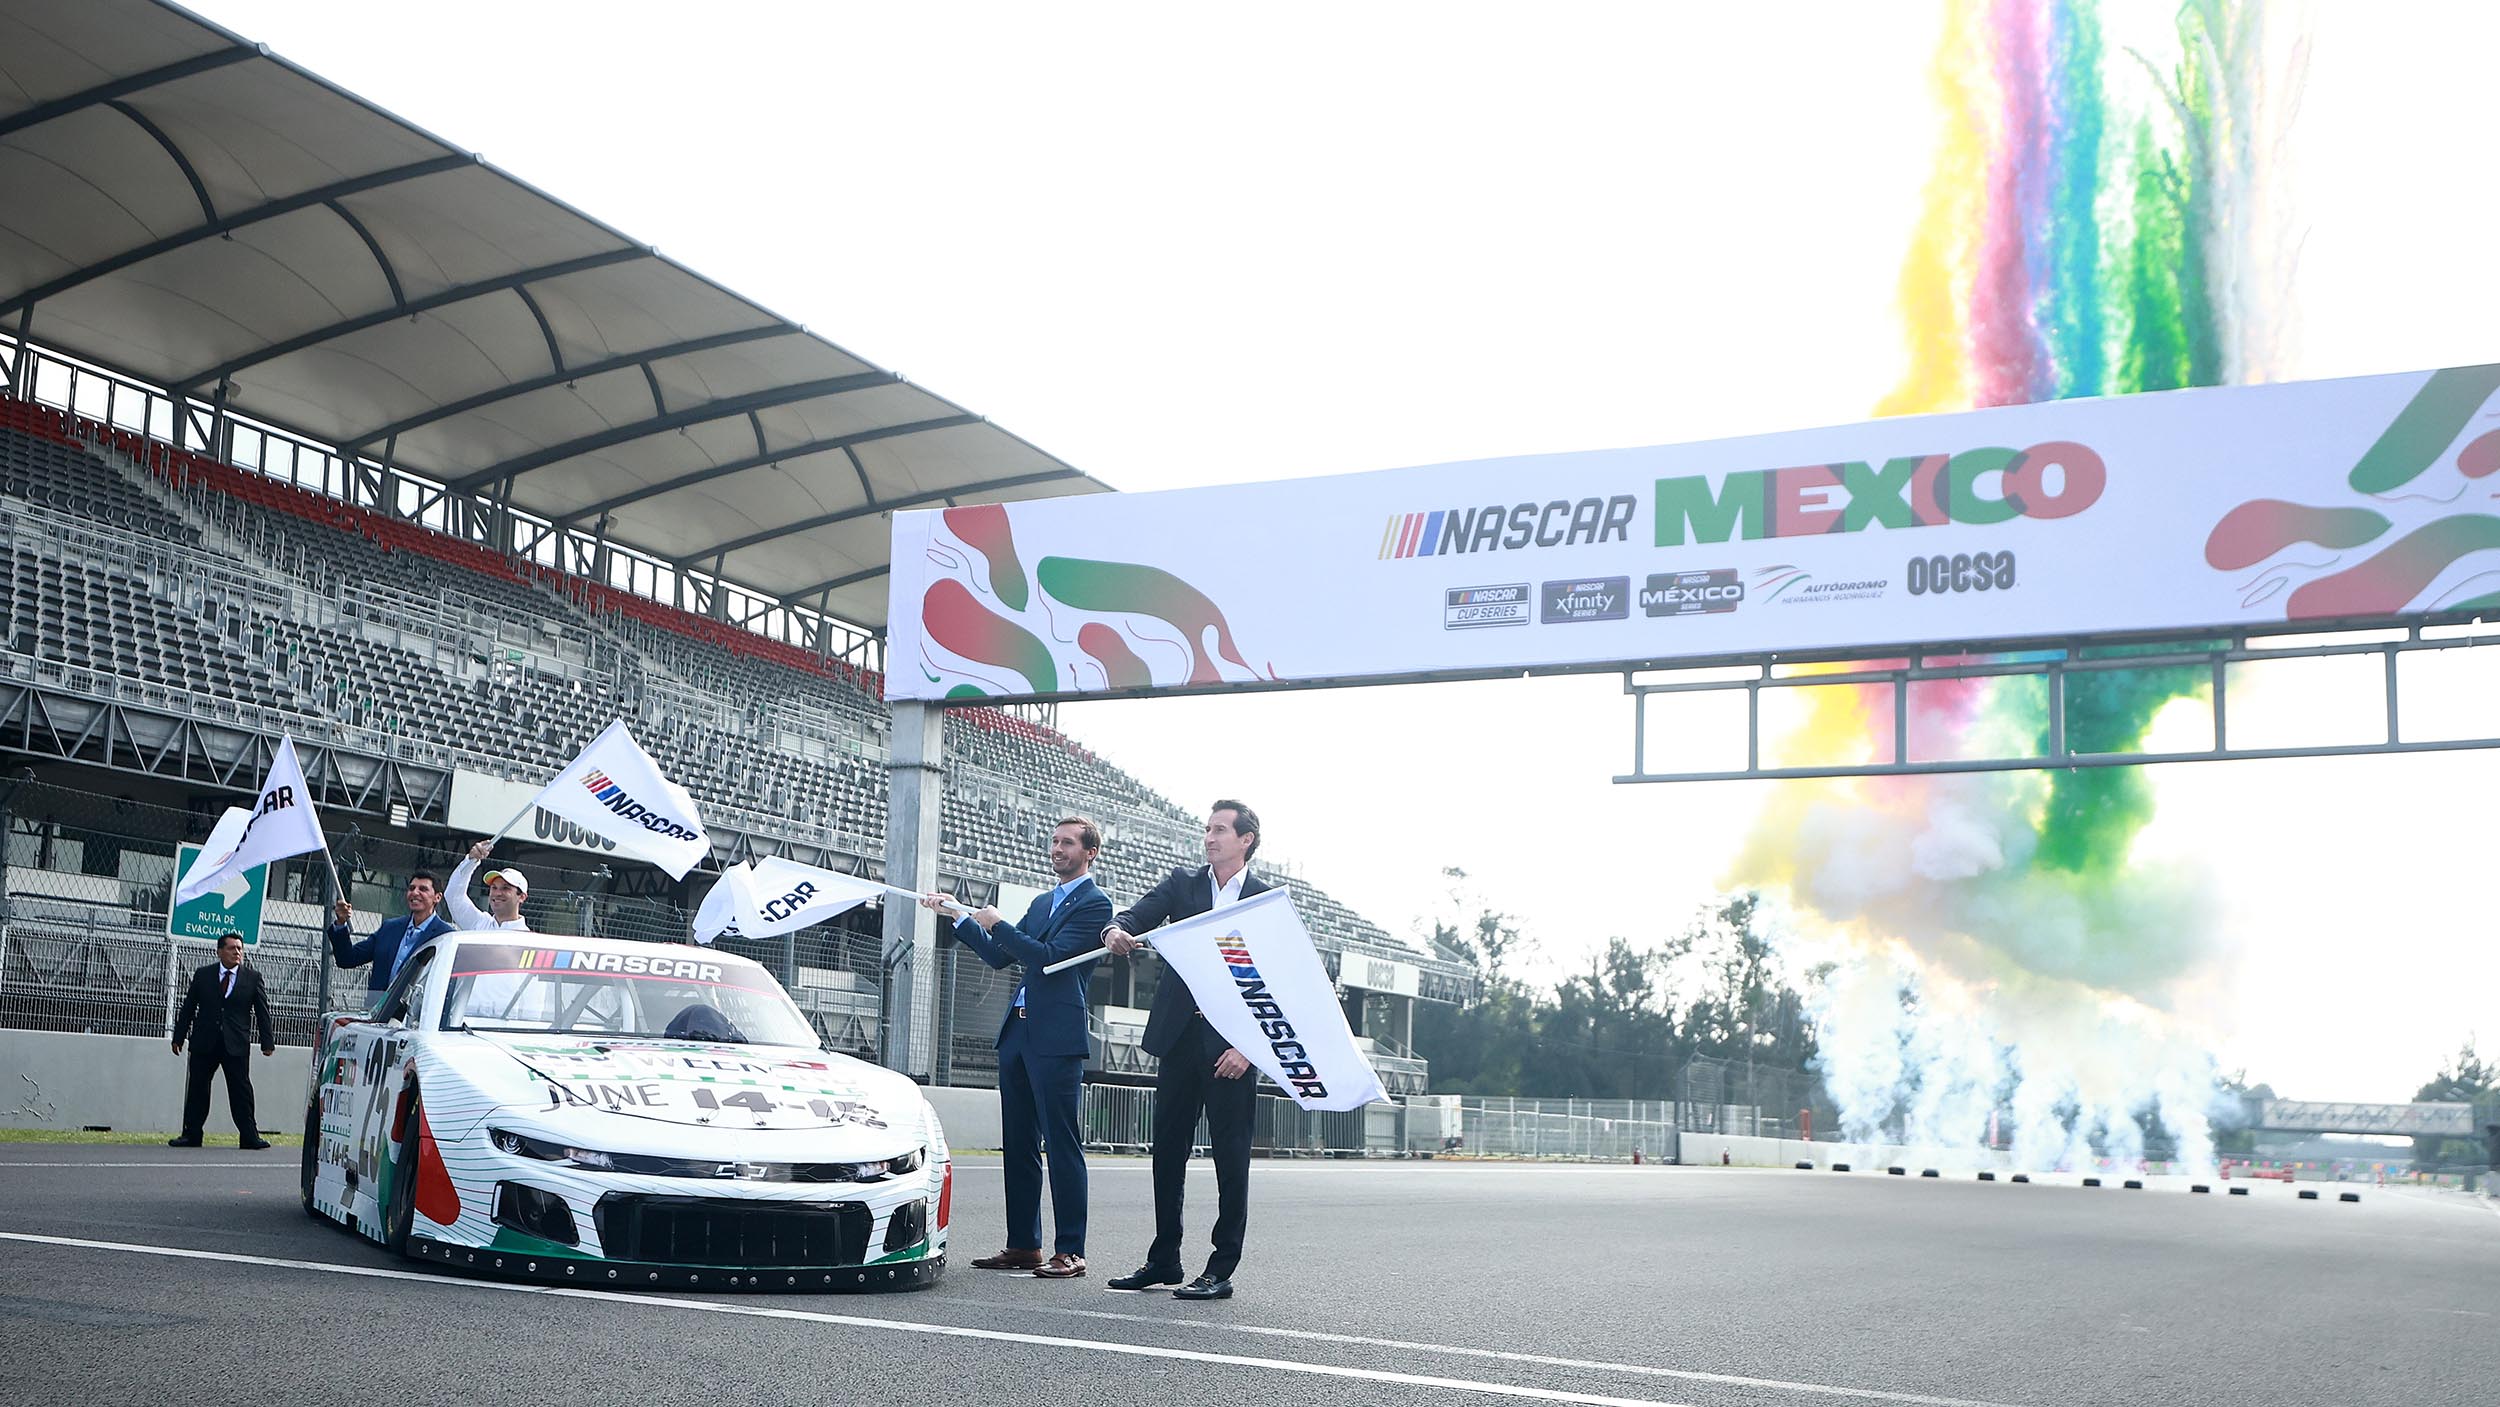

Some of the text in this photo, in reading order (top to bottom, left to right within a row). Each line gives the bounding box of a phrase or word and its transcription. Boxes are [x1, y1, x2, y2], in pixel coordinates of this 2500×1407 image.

[1438, 440, 2107, 555] NASCAR MEXICO
[1575, 582, 1606, 592] NASCAR
[1682, 575, 1711, 584] NASCAR
[1804, 579, 1888, 593] AUTÓDROMO
[1473, 588, 1518, 603] NASCAR
[1642, 582, 1742, 604] MÉXICO
[1556, 592, 1615, 614] xfinity
[1680, 602, 1703, 611] SERIES
[1457, 606, 1518, 620] CUP SERIES
[1572, 608, 1598, 617] SERIES
[604, 792, 698, 842] NASCAR
[198, 911, 235, 925] RUTA DE
[570, 951, 722, 983] NASCAR
[1235, 979, 1329, 1099] NASCAR
[540, 1083, 670, 1113] JUNE
